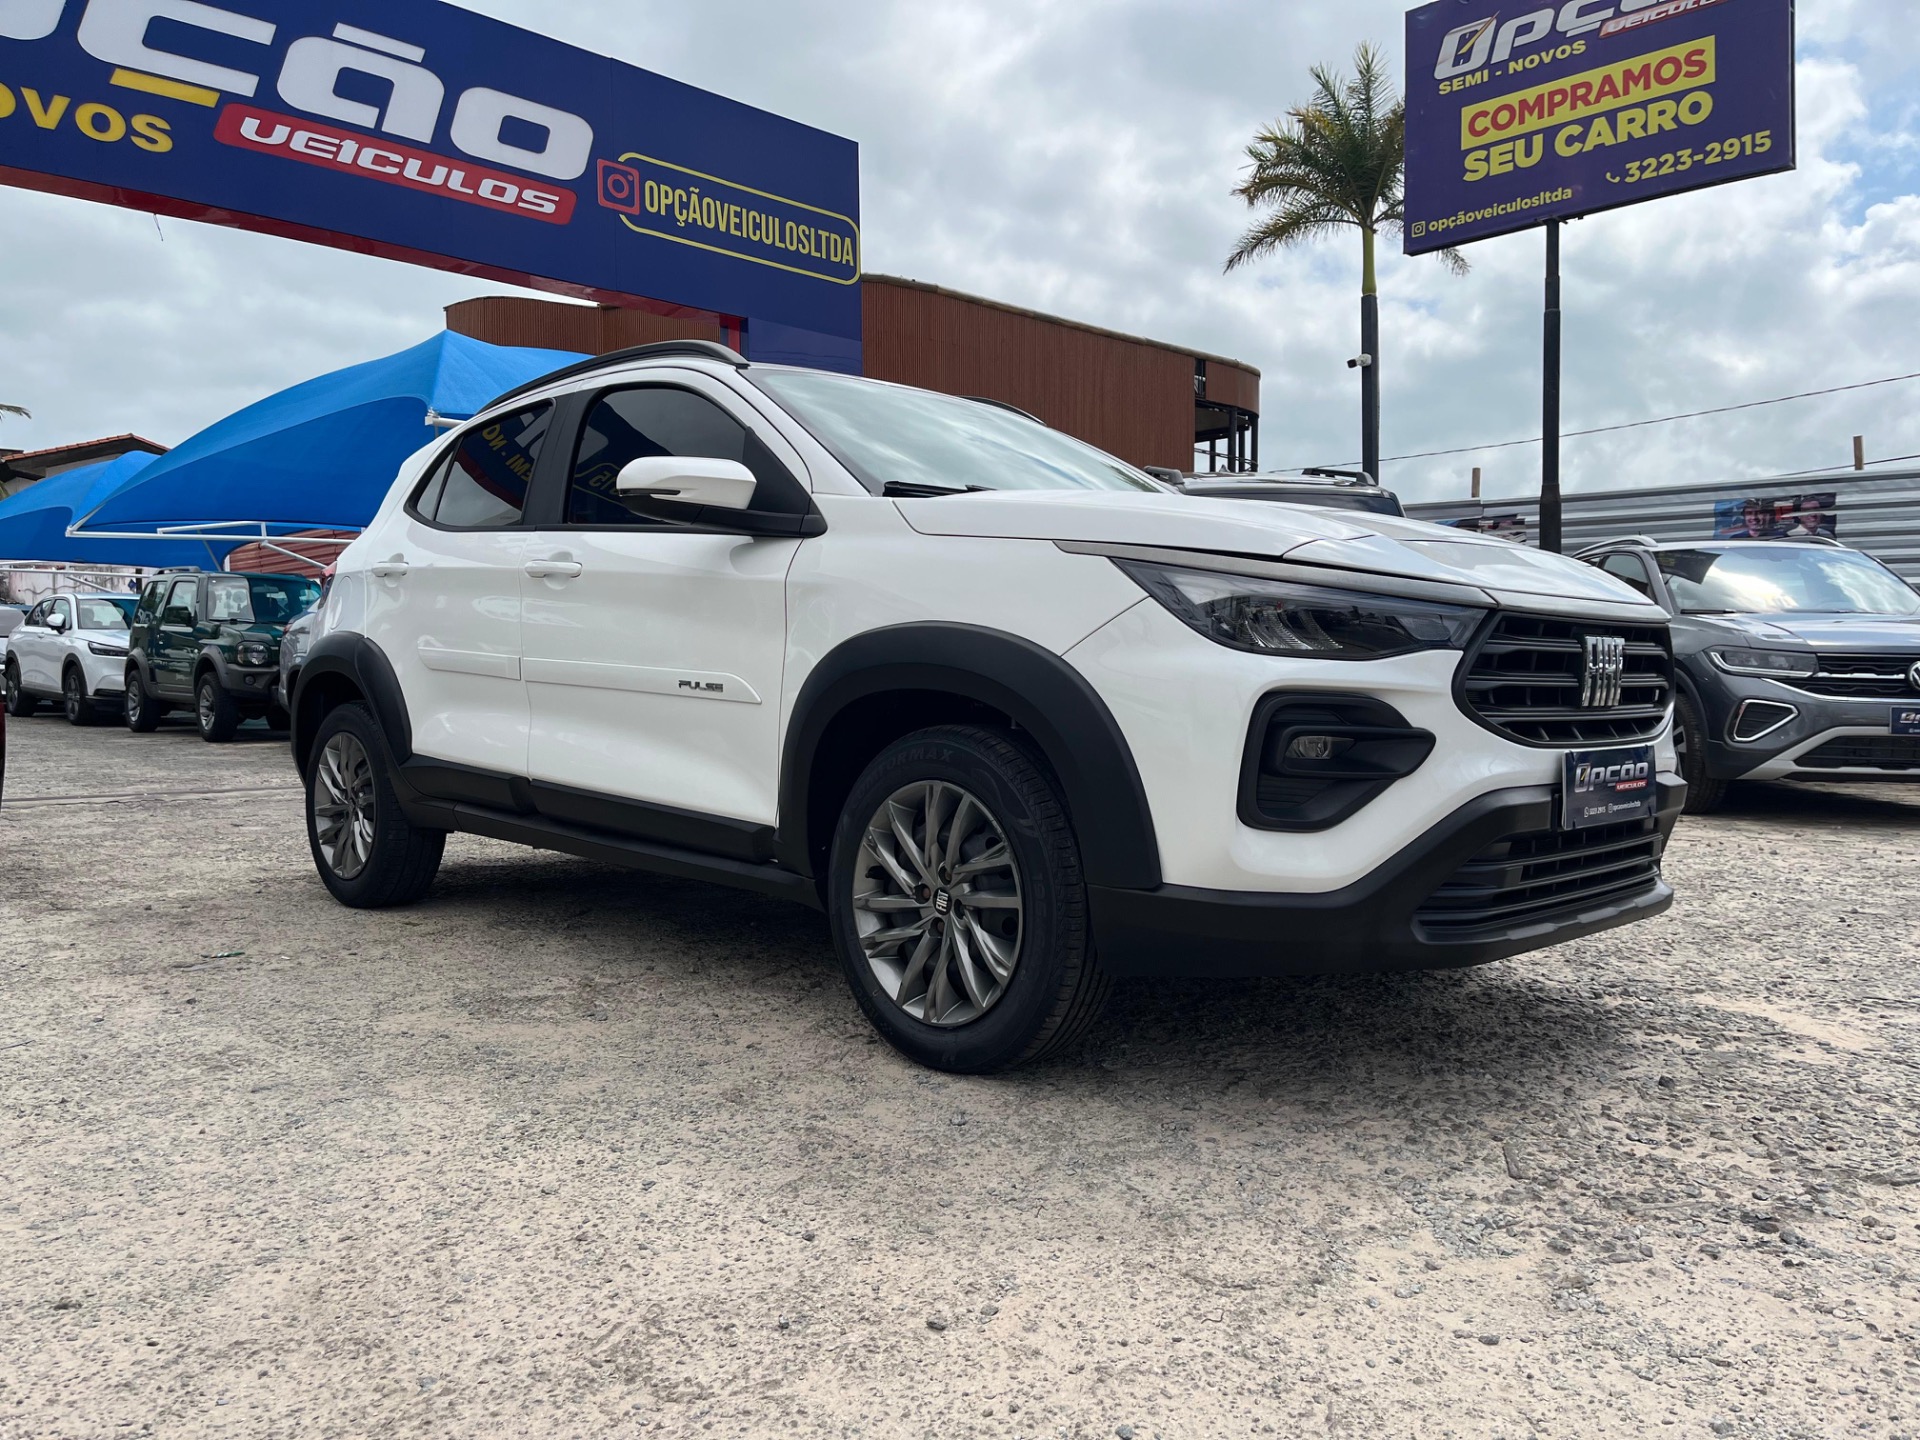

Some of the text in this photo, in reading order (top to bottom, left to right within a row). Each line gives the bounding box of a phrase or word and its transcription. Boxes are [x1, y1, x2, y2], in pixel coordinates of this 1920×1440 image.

[1438, 69, 1489, 95] SEMI
[1509, 40, 1586, 75] NOVOS
[1467, 48, 1707, 138] COMPRAMOS
[1463, 91, 1714, 182] SEU CARRO
[1624, 130, 1772, 183] 3223-2915
[644, 180, 854, 266] OPÇÃOVEICULOSLTDA
[1428, 187, 1573, 232] opçãoveiculosltda
[678, 680, 723, 692] PULSE
